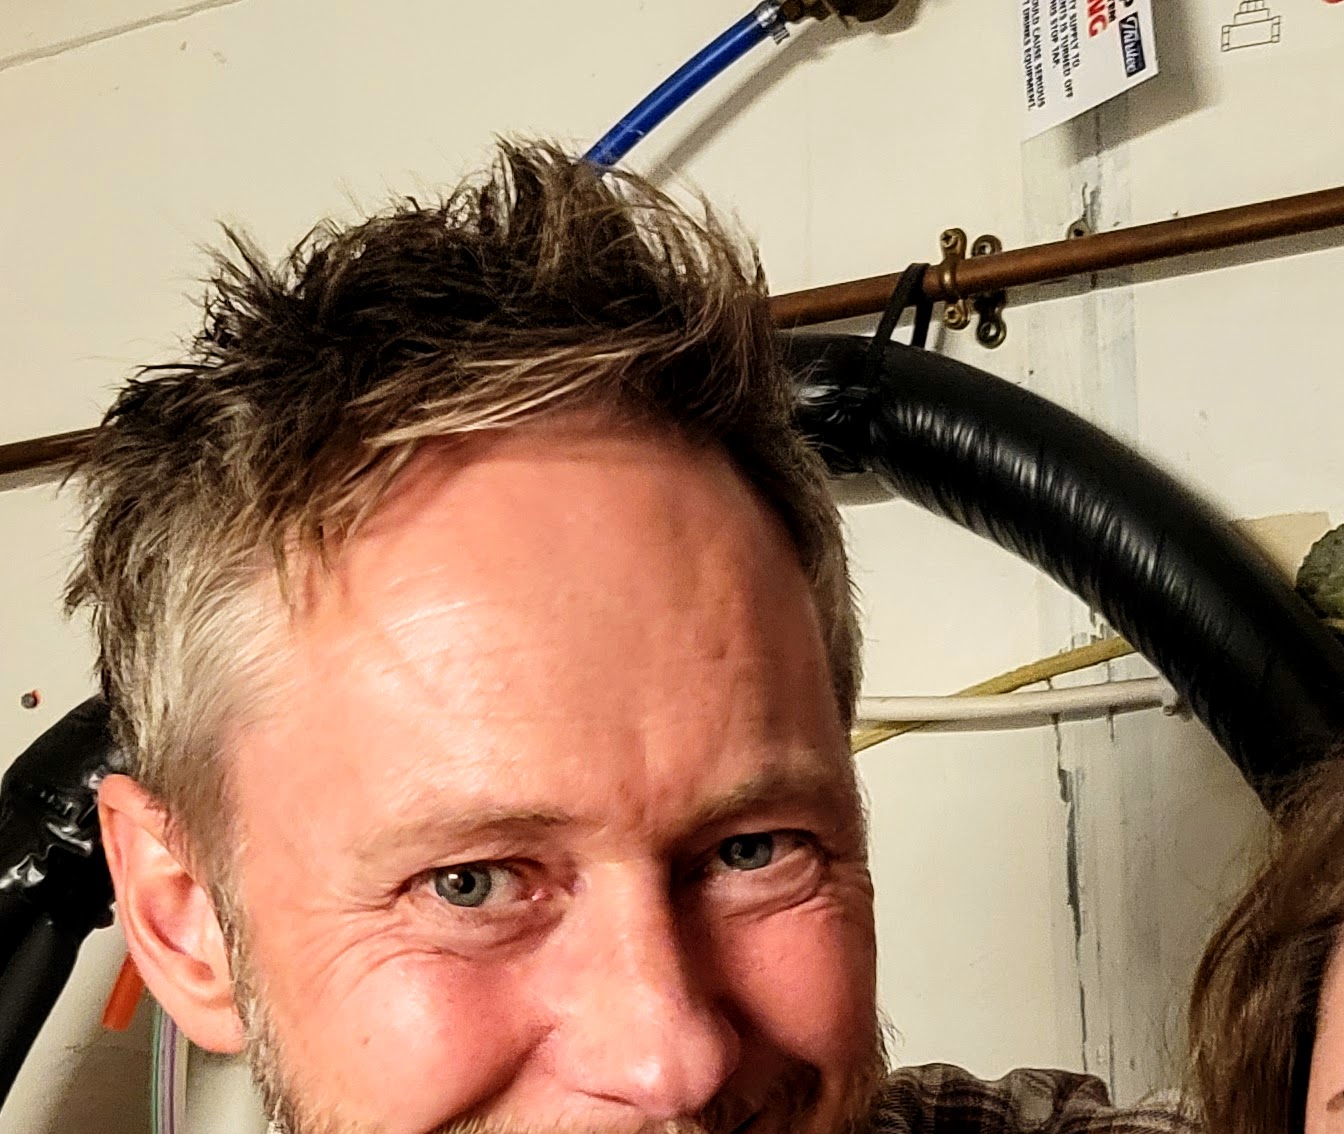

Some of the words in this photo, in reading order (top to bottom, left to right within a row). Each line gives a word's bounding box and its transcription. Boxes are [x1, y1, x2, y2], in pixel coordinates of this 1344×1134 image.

[1022, 7, 1032, 46] DRINKS
[1050, 17, 1059, 43] STOP
[1059, 21, 1069, 33] IS
[1069, 12, 1079, 50] SUPPLY
[1032, 27, 1042, 61] CAUSE
[1051, 45, 1060, 68] TAP.
[1060, 34, 1071, 77] TURNED
[1071, 52, 1080, 68] TO
[1023, 47, 1036, 111] EQUIPMENT.
[1034, 63, 1046, 108] SERIOUS
[1064, 78, 1074, 98] OFF
